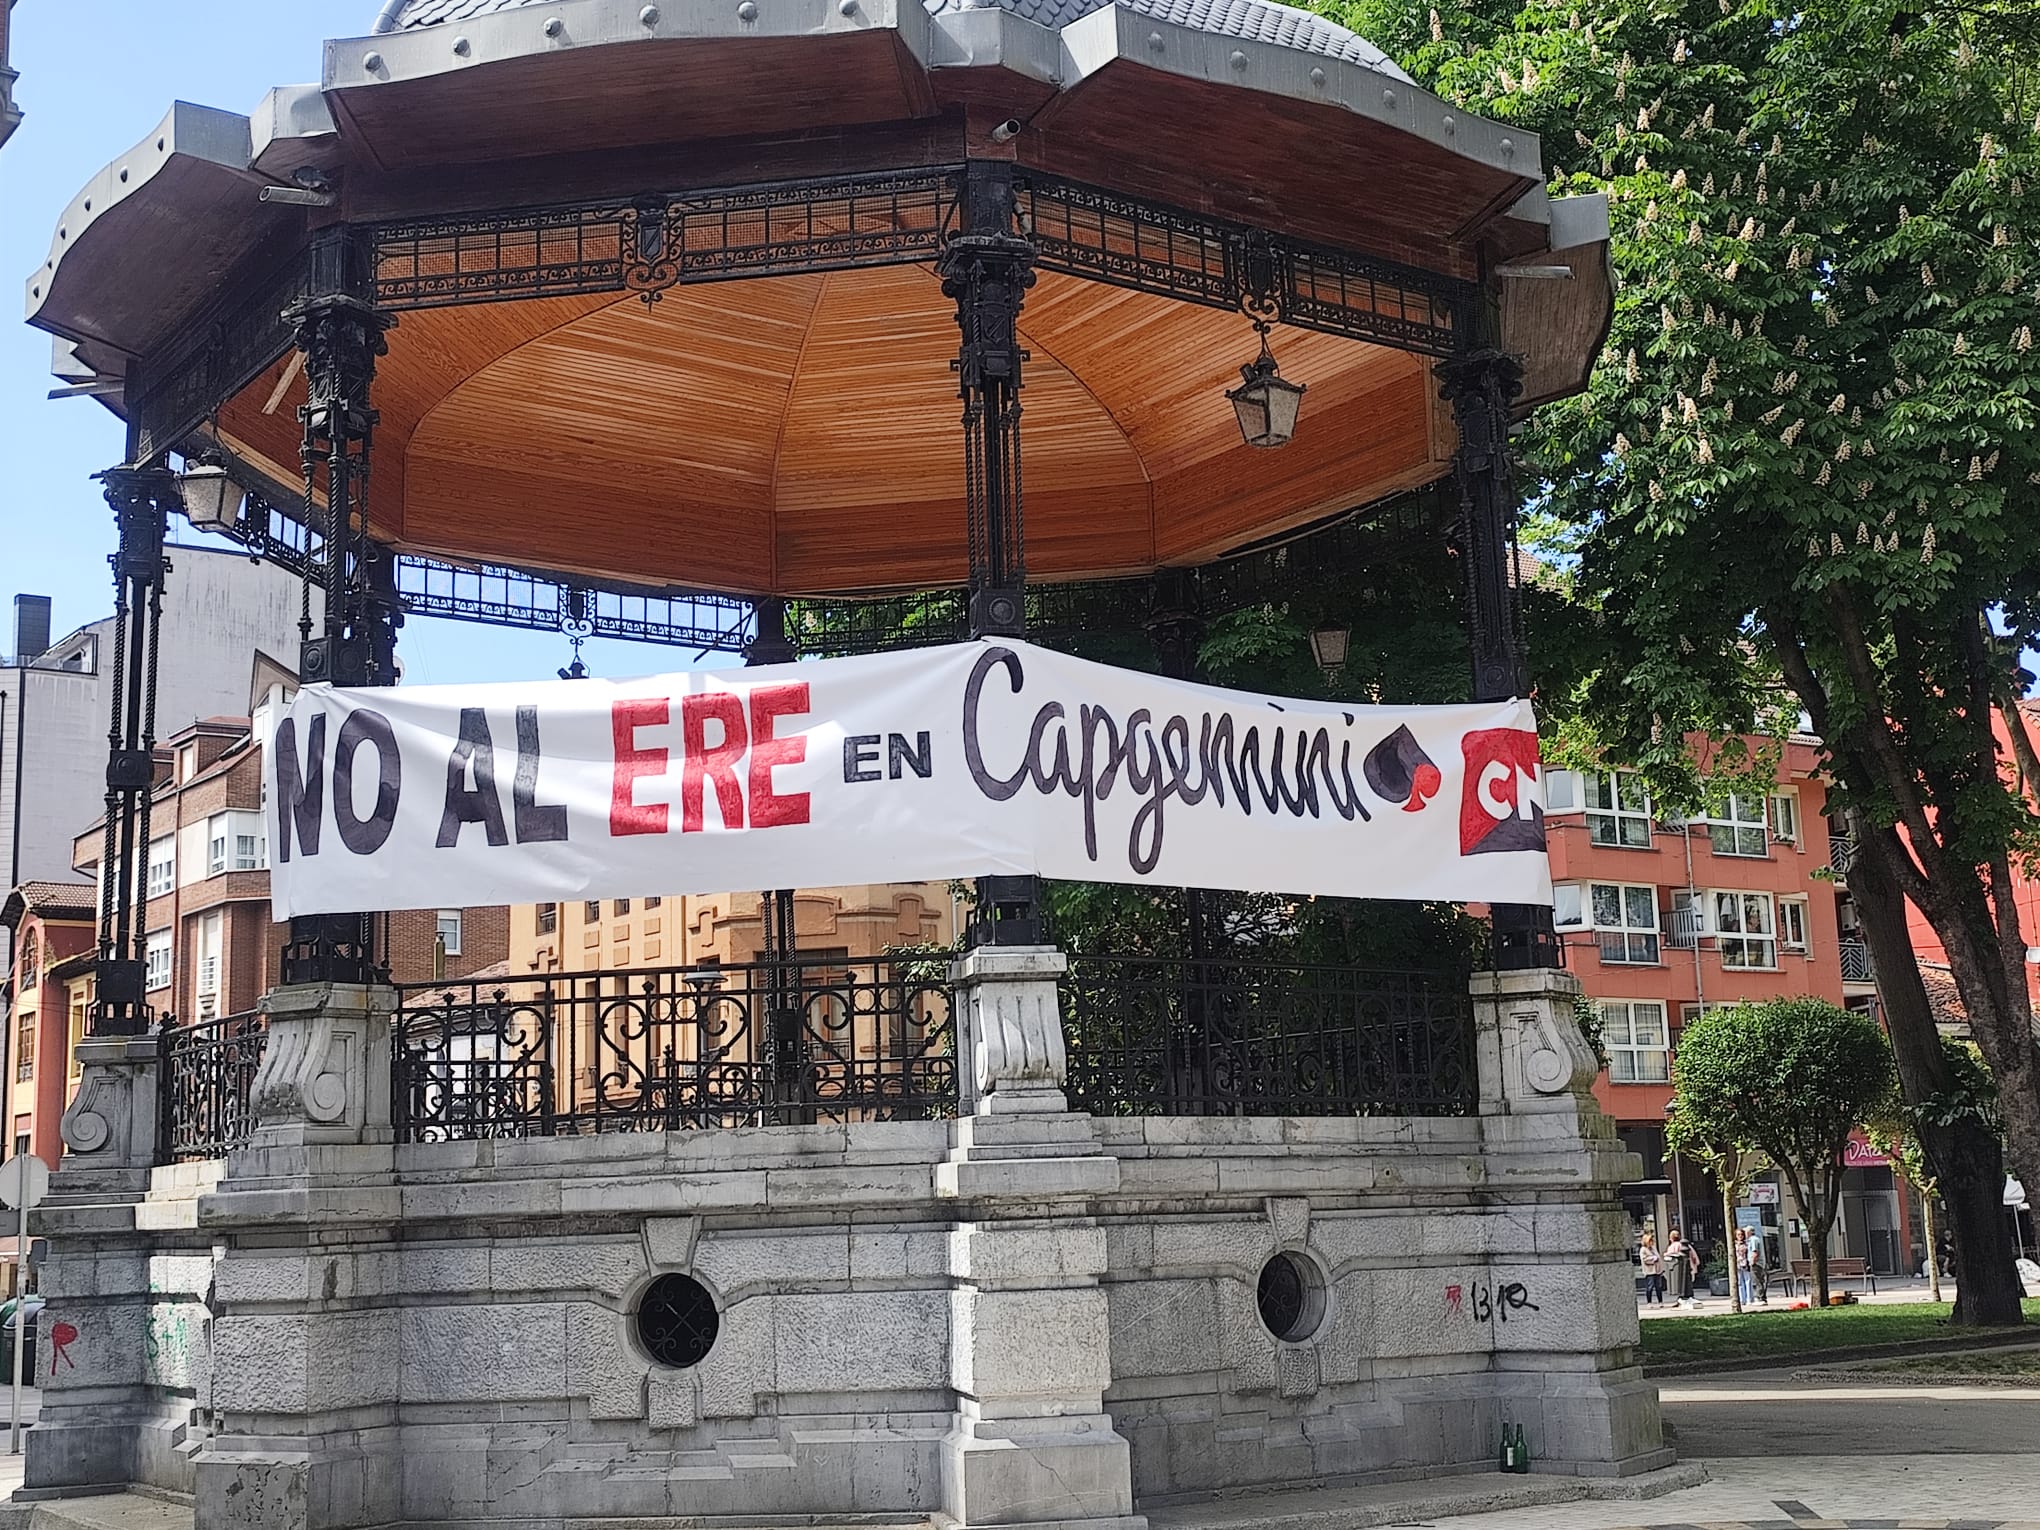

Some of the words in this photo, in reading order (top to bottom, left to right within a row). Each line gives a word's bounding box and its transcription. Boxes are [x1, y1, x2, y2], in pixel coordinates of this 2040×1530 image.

[275, 707, 401, 864] NO
[435, 704, 569, 849] AL
[609, 681, 811, 837] ERE
[843, 731, 932, 784] EN
[963, 646, 1372, 875] Capgemini
